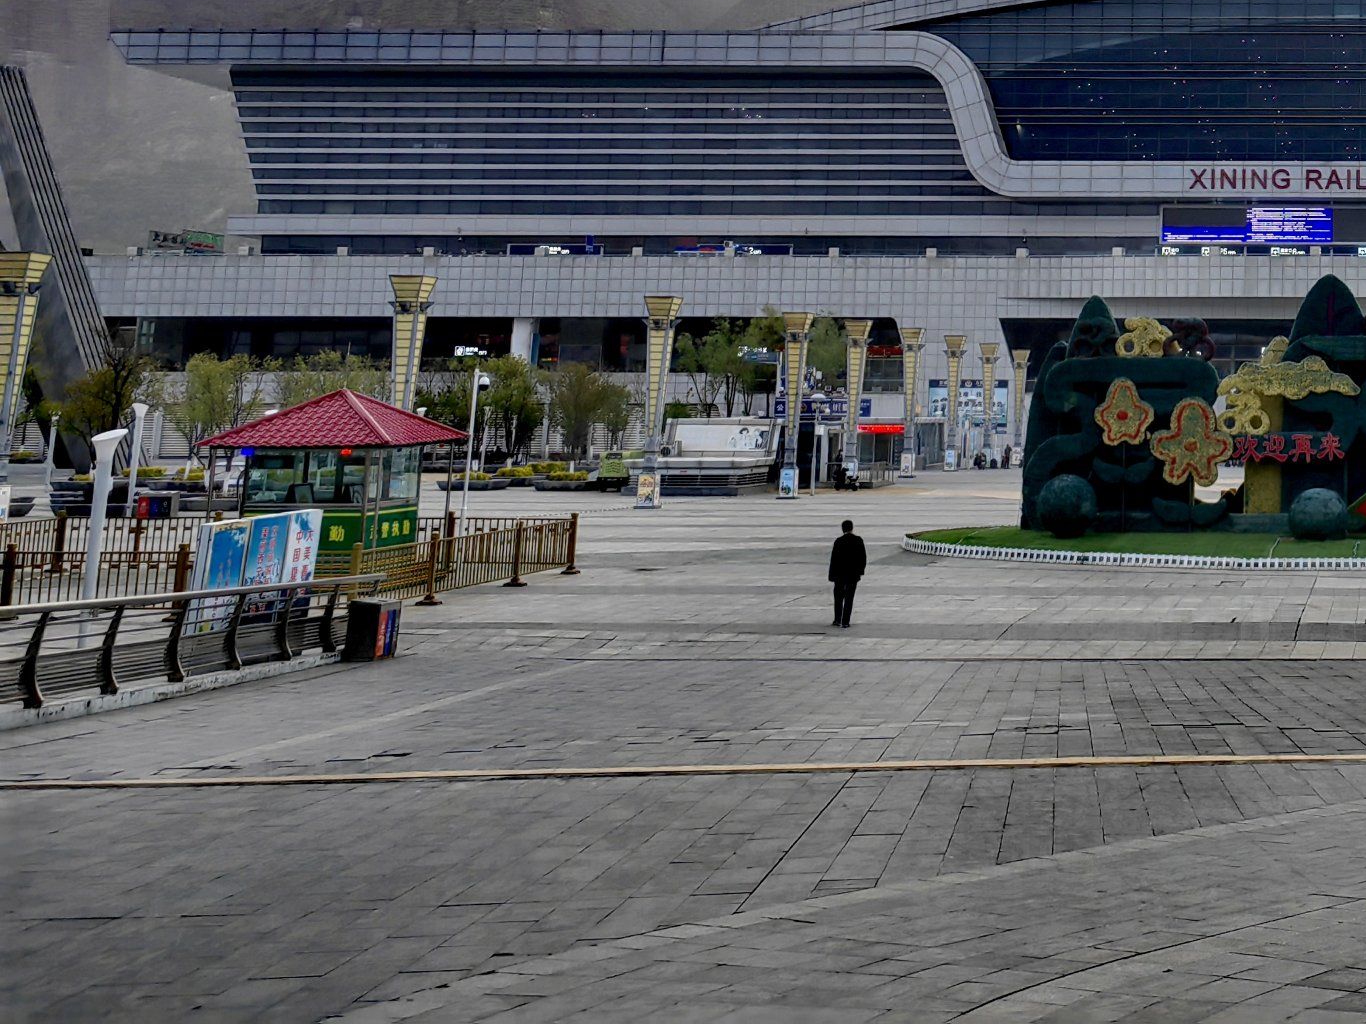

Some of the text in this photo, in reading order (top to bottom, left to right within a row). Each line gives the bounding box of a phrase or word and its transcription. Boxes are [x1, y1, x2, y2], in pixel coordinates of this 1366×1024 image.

[1189, 169, 1292, 192] XINING
[1232, 432, 1345, 463] 欢迎再来
